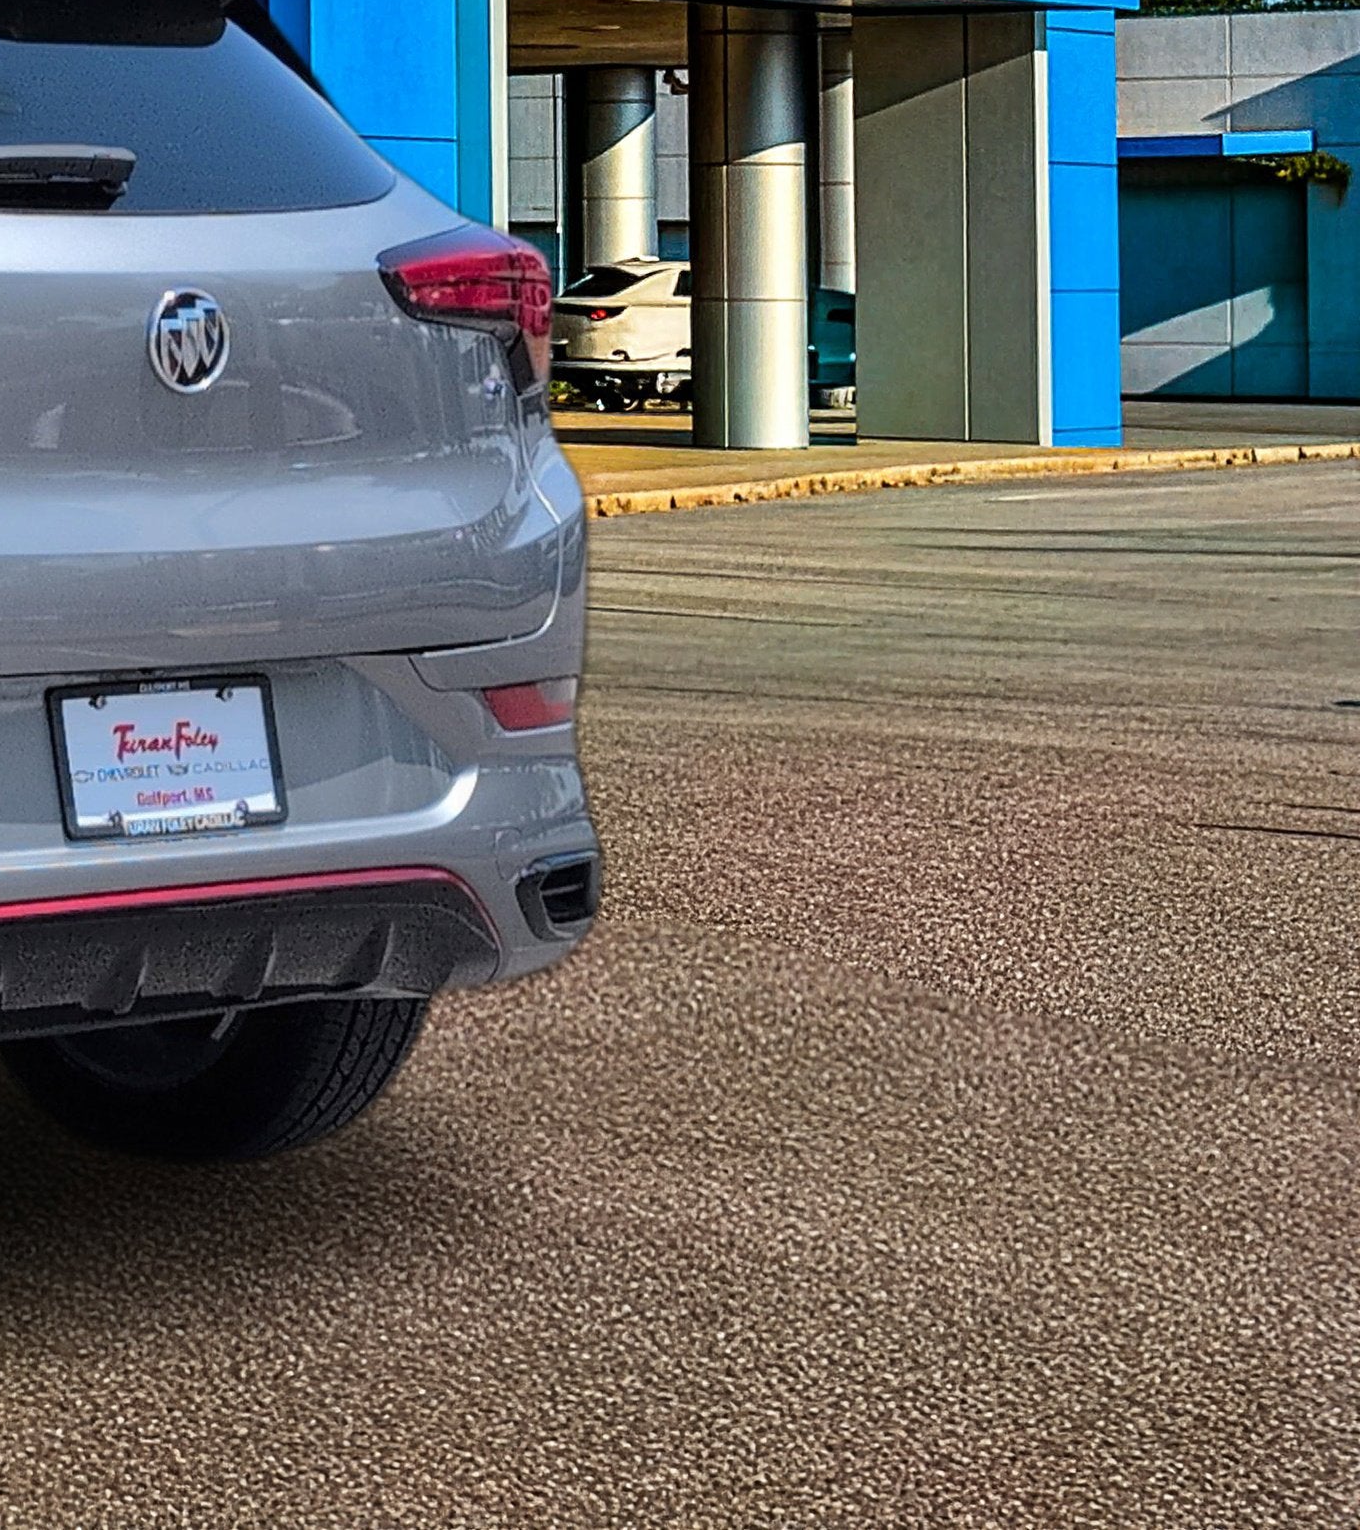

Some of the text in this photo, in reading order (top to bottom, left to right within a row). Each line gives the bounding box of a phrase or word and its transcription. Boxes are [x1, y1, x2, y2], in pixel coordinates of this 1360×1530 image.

[113, 720, 218, 763] Turan Foley
[192, 758, 269, 774] CADILLAC
